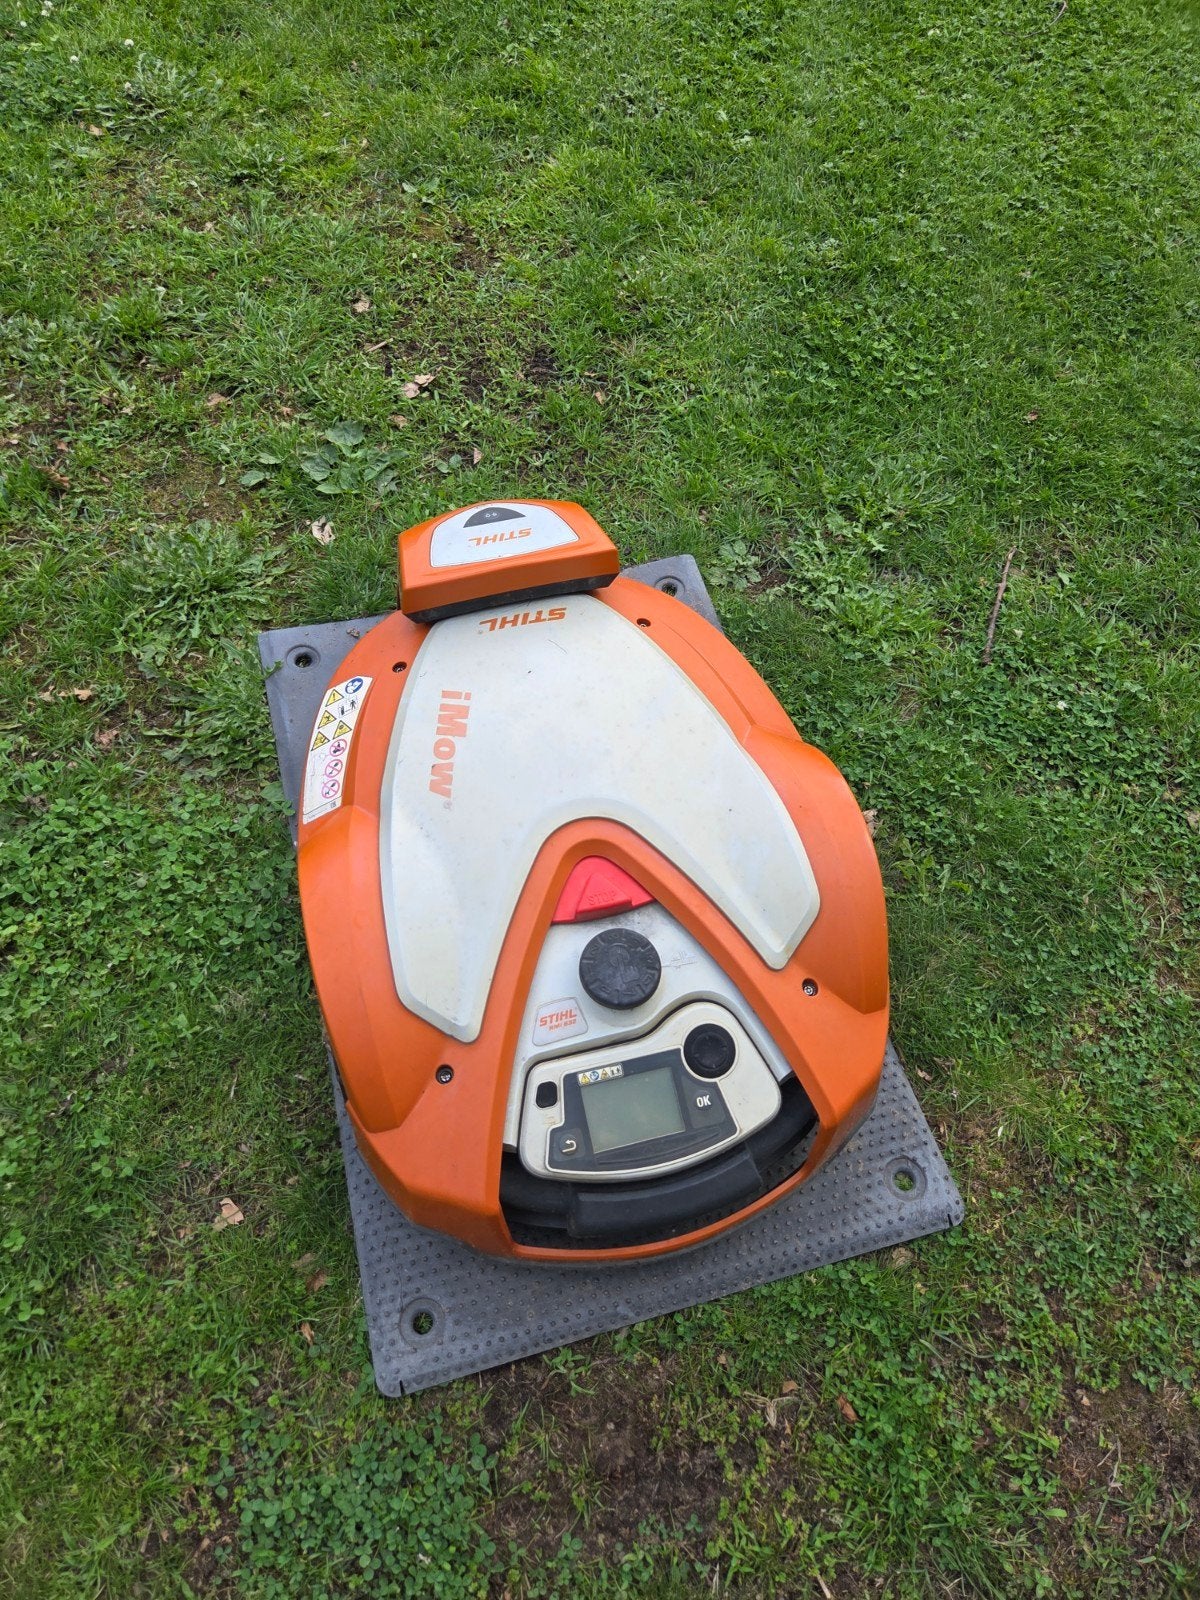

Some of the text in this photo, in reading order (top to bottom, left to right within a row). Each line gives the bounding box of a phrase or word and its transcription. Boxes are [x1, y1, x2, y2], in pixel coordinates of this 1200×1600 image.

[468, 528, 532, 546] STIHL
[479, 607, 567, 632] STIHL
[586, 890, 616, 905] STOP
[539, 1008, 577, 1027] STIHL
[696, 1094, 712, 1108] OK
